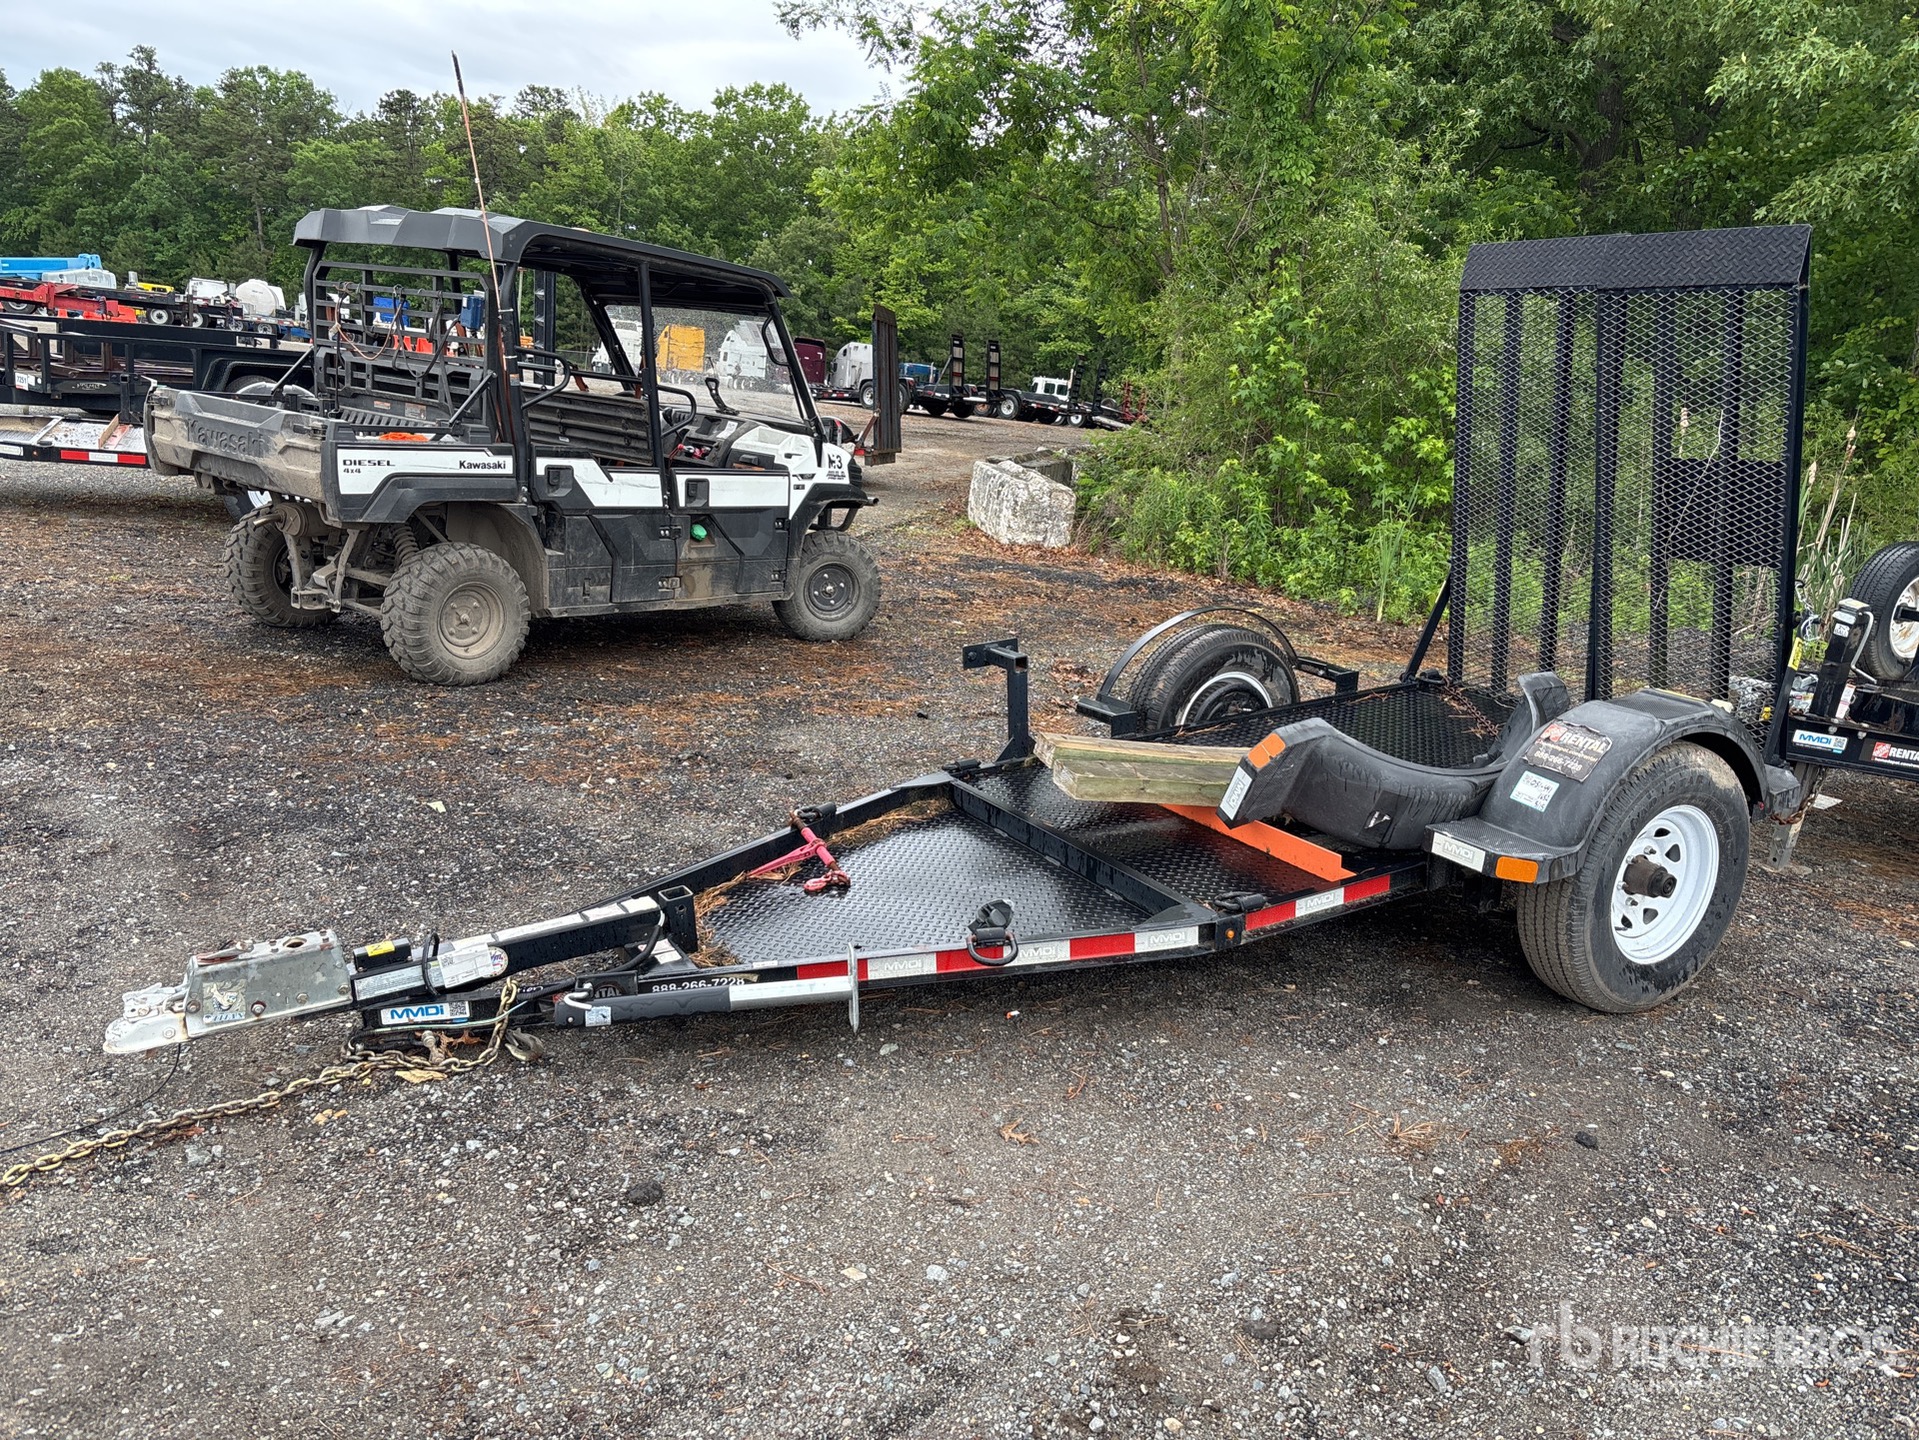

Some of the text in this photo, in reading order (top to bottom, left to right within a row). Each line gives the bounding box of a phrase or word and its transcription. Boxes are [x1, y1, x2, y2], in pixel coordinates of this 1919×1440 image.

[186, 419, 265, 458] Kawasaki
[342, 459, 396, 467] DIESEL
[458, 460, 506, 470] Kawasaki
[1559, 732, 1607, 754] RENTAL
[1799, 733, 1832, 745] MMDi
[389, 1005, 445, 1020] MMDi
